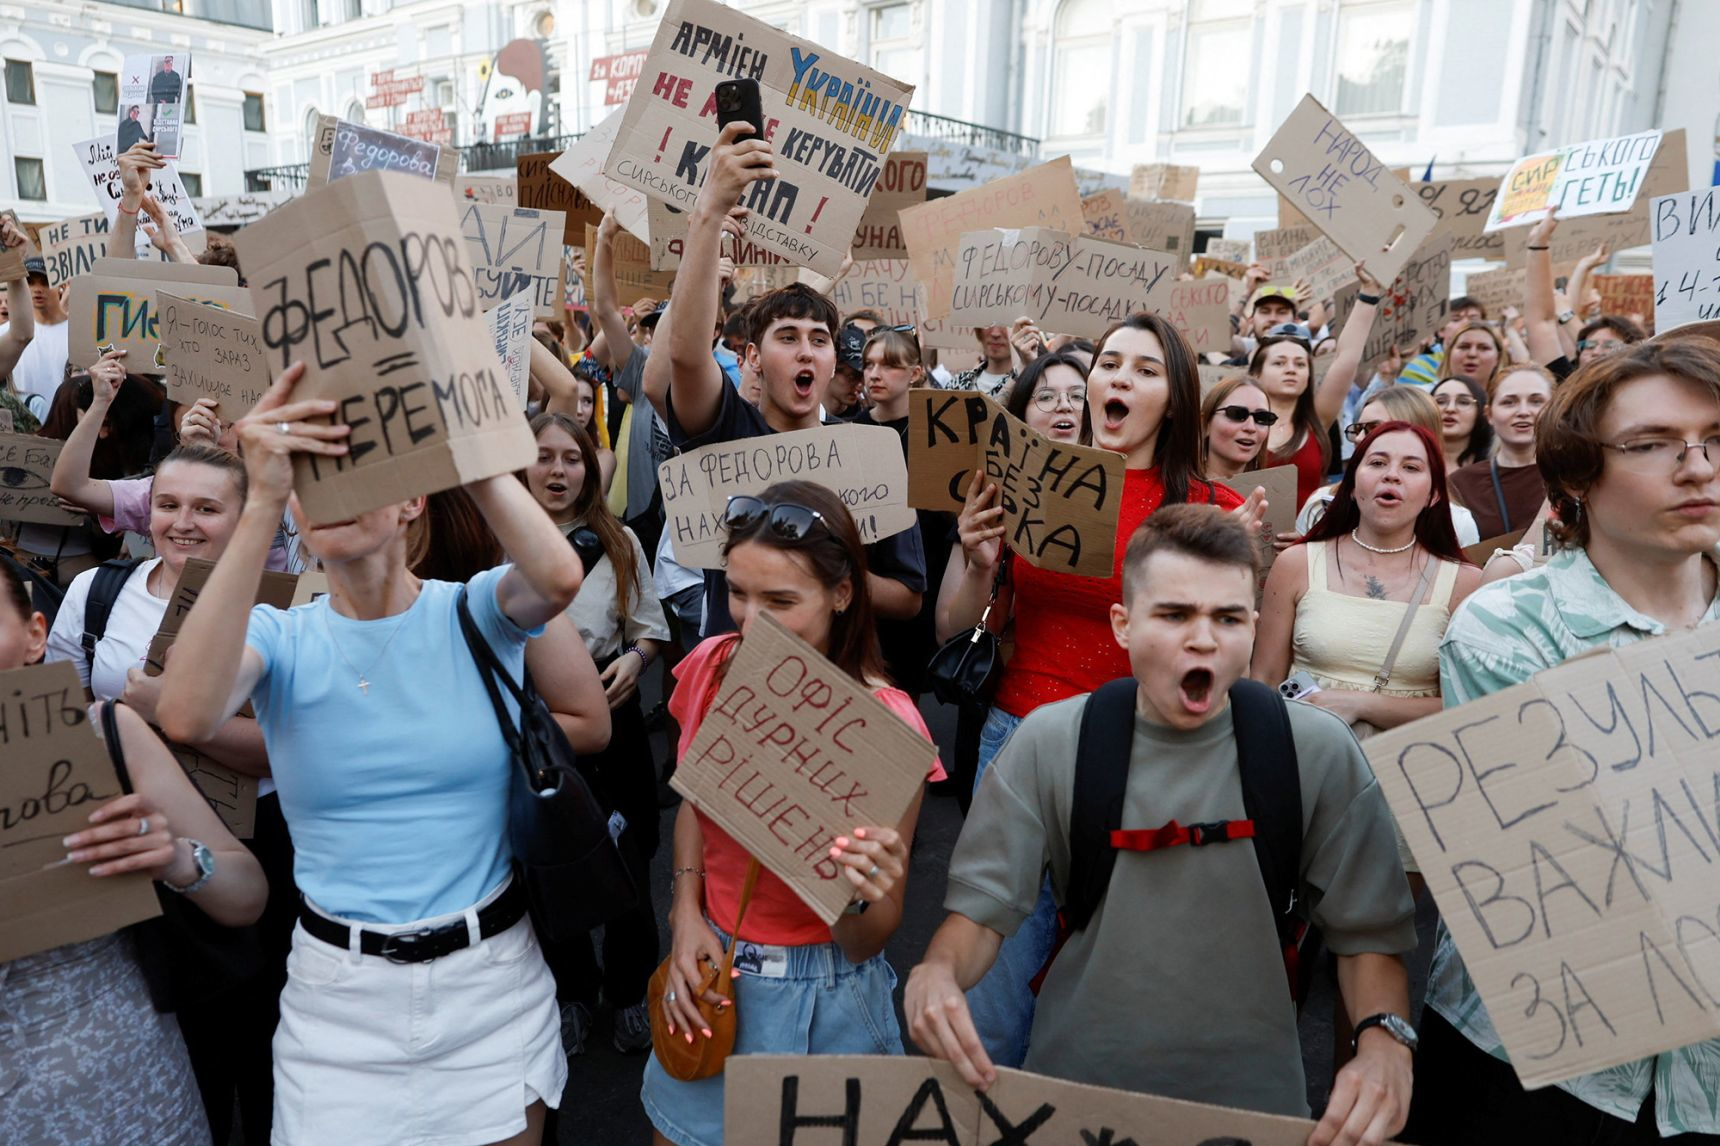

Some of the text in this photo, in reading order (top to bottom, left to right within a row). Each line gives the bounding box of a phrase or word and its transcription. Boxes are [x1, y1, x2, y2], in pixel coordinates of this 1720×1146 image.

[610, 53, 648, 78] КОРП
[338, 130, 434, 176] Федорова
[652, 71, 693, 109] НЕ
[699, 92, 780, 145] МЕ
[781, 127, 881, 197] КЕРУВАТИ
[1313, 119, 1385, 193] НАРОД
[616, 160, 698, 207] СИРСЬКОГ
[674, 140, 800, 226] КАП
[1288, 174, 1342, 220] ЛОХ
[1316, 163, 1350, 196] НЕ
[1555, 166, 1641, 211] ГЕТЬ!
[49, 222, 69, 245] НЕ
[1657, 190, 1720, 242] ВИ
[262, 231, 477, 369] ФЕДОРОВ
[214, 347, 252, 372] ЗАРАЗ
[663, 439, 842, 501] ЗА ФЕДОРОВА
[926, 396, 1108, 511] КРАЇНА
[985, 449, 1043, 509] БЕЗ
[675, 512, 729, 543] НАХ
[948, 468, 1081, 568] СРКА
[765, 655, 867, 754] ОФІС
[713, 685, 868, 819] ДУРНИХ
[1397, 653, 1720, 853] РЕЗУЛЬ
[696, 734, 840, 881] РІШЕНЬ
[1509, 960, 1617, 1060] ЗА
